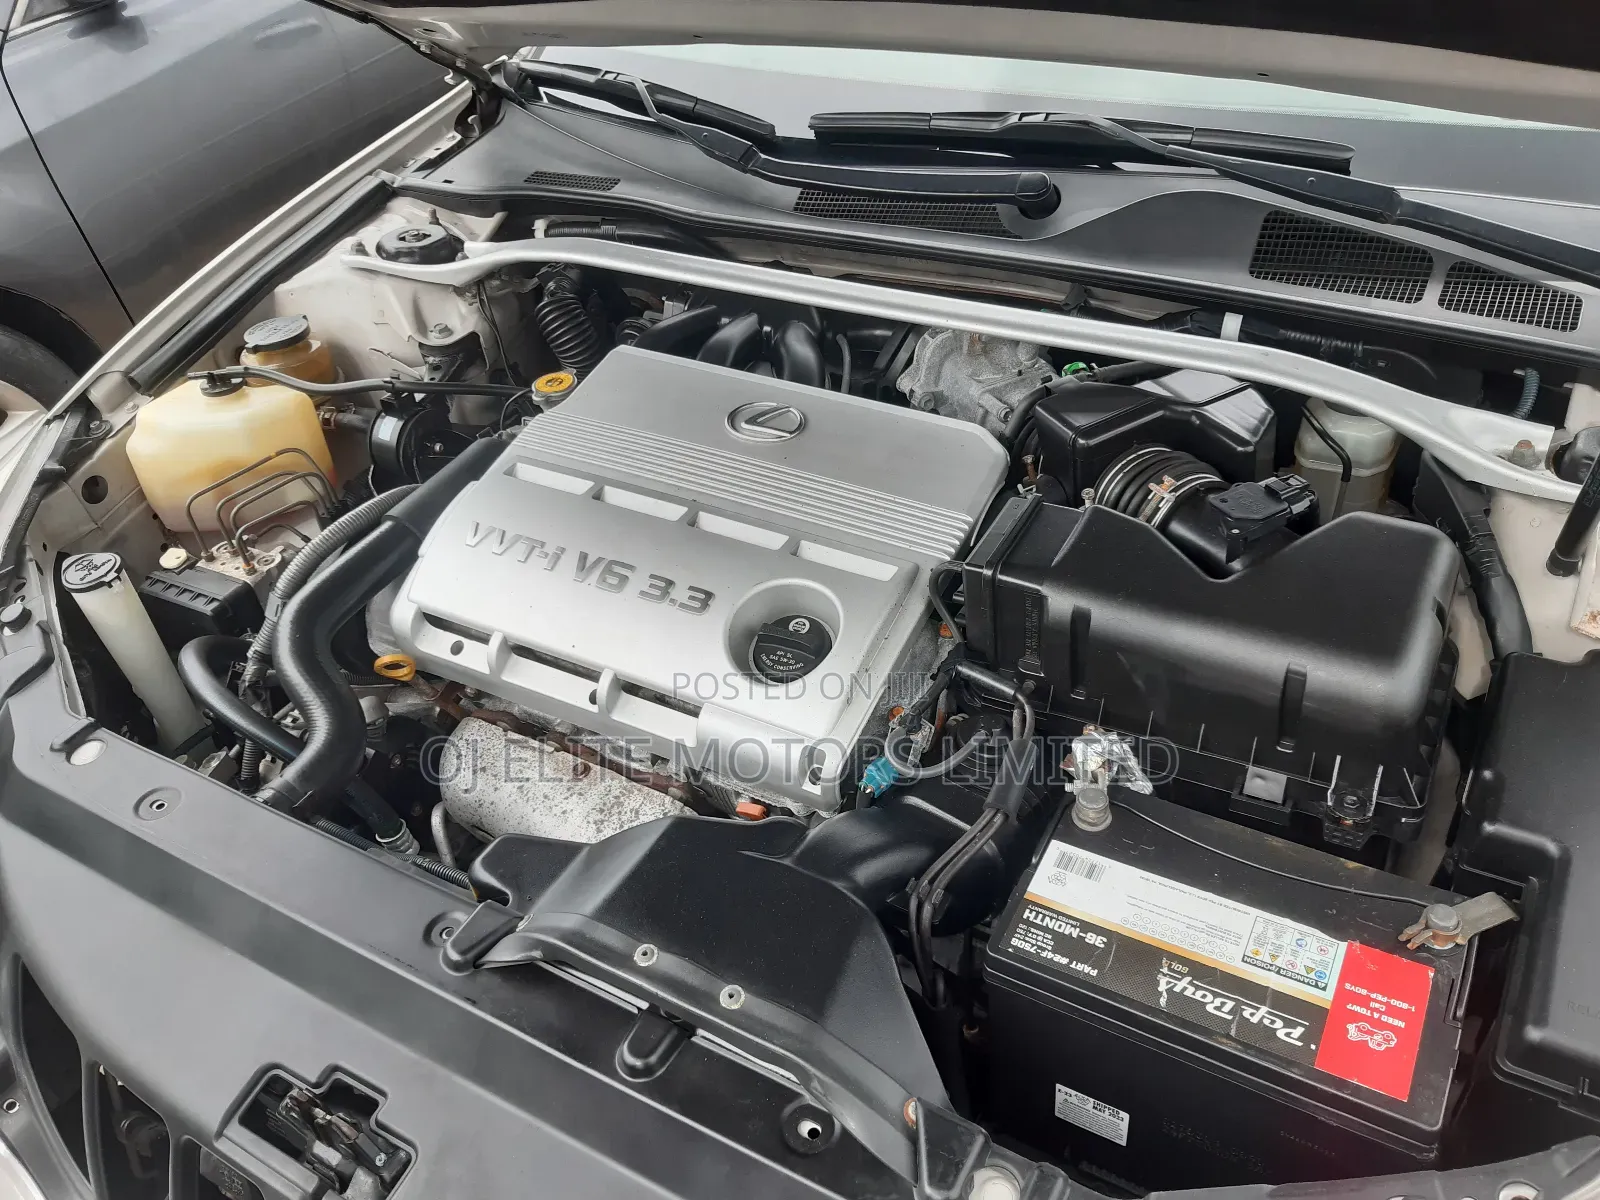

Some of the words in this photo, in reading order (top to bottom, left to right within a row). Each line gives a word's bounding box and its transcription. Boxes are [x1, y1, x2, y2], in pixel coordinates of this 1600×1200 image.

[464, 520, 565, 571] VVT-i
[574, 551, 637, 594] V6
[638, 573, 716, 615] 3.3
[1028, 905, 1057, 918] WARRANTY
[1058, 916, 1079, 926] LIMITED
[1023, 909, 1107, 948] 36-MONTH
[1070, 961, 1098, 976] PART
[1279, 968, 1316, 984] DANGER
[1157, 975, 1235, 1019] Boys
[1345, 983, 1415, 1012] 1-800-PEP-BOYS
[1347, 1004, 1372, 1015] TOW?
[1370, 1002, 1385, 1011] Call
[1241, 1005, 1305, 1046] Pep
[1381, 1015, 1405, 1027] NEED
[1093, 1101, 1120, 1115] SHIPPED
[1093, 1106, 1106, 1114] MAY
